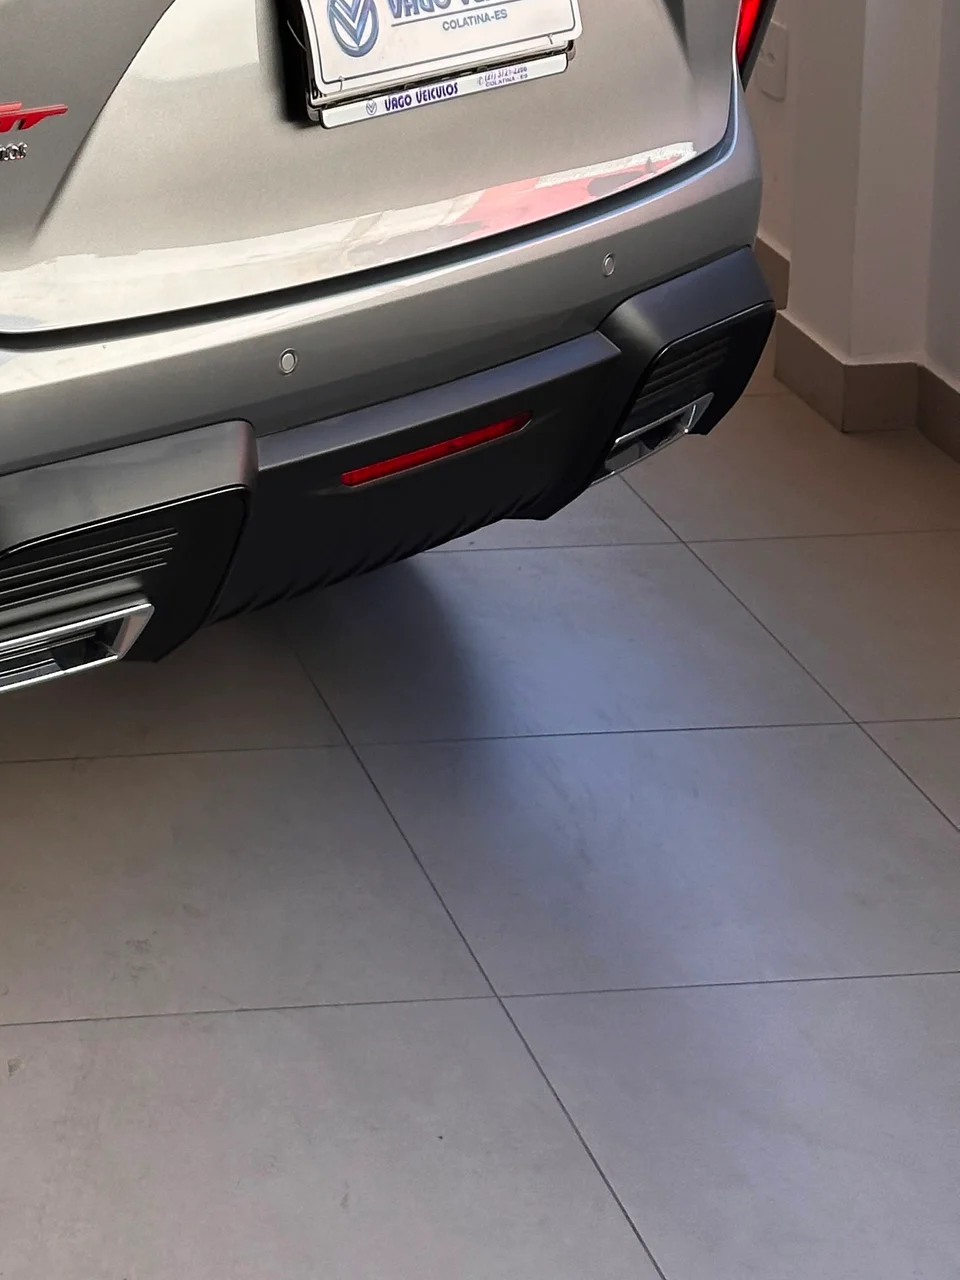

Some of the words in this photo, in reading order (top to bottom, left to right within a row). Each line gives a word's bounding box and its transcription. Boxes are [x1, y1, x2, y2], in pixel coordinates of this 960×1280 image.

[442, 8, 508, 31] COLATINA-ES
[384, 94, 412, 111] VAGO
[415, 82, 458, 104] VEICULOS
